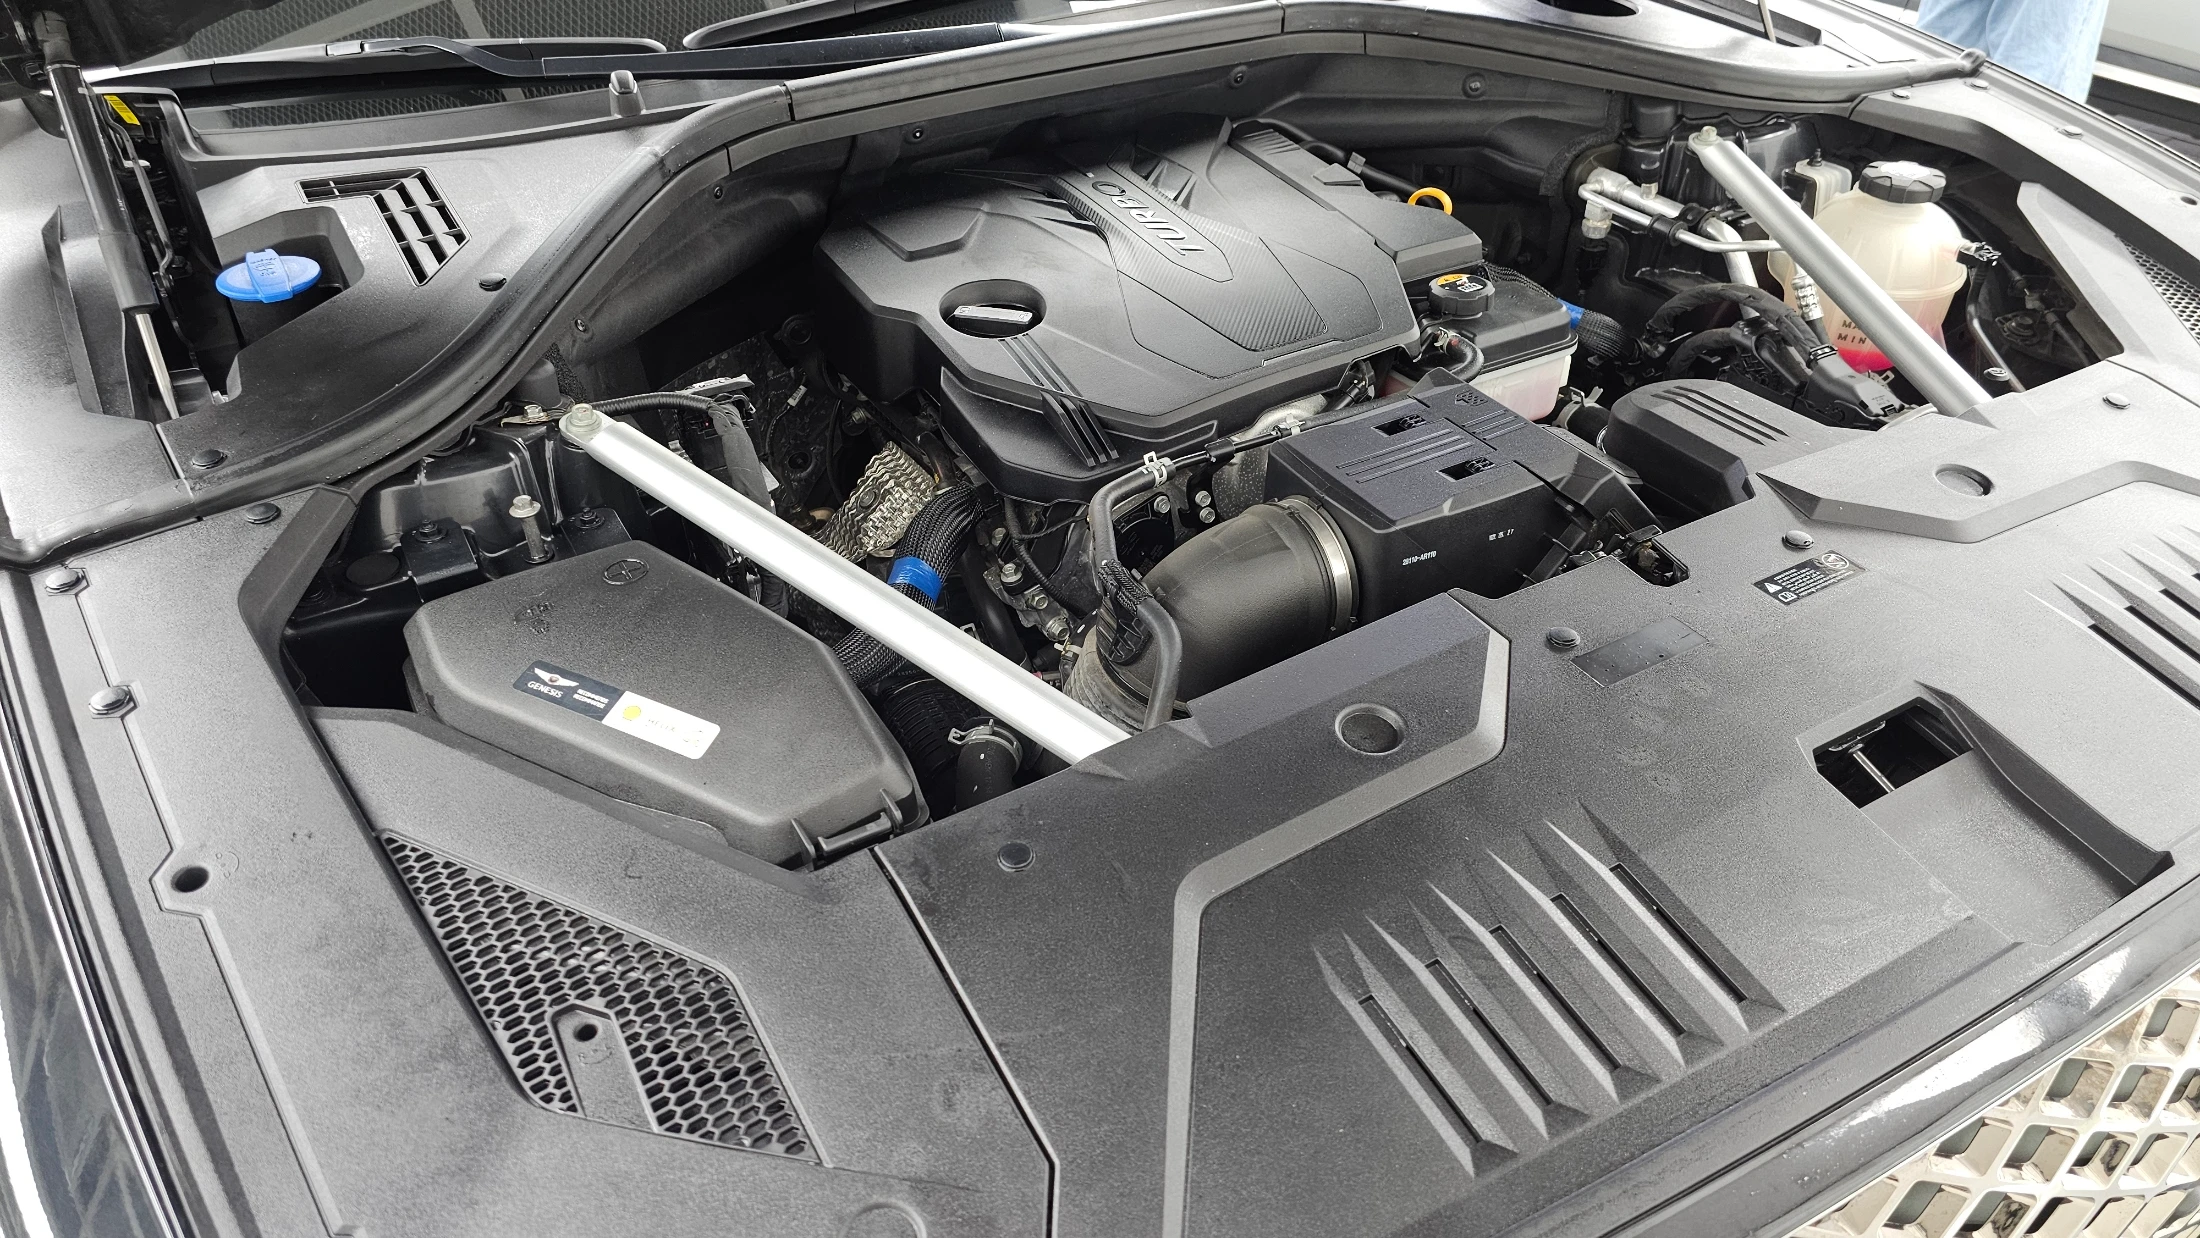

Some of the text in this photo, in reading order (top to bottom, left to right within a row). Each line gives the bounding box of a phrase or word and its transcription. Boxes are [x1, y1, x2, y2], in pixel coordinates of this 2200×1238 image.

[1091, 181, 1205, 257] TURBO
[1837, 332, 1867, 345] MIN
[527, 680, 563, 699] GENESIS
